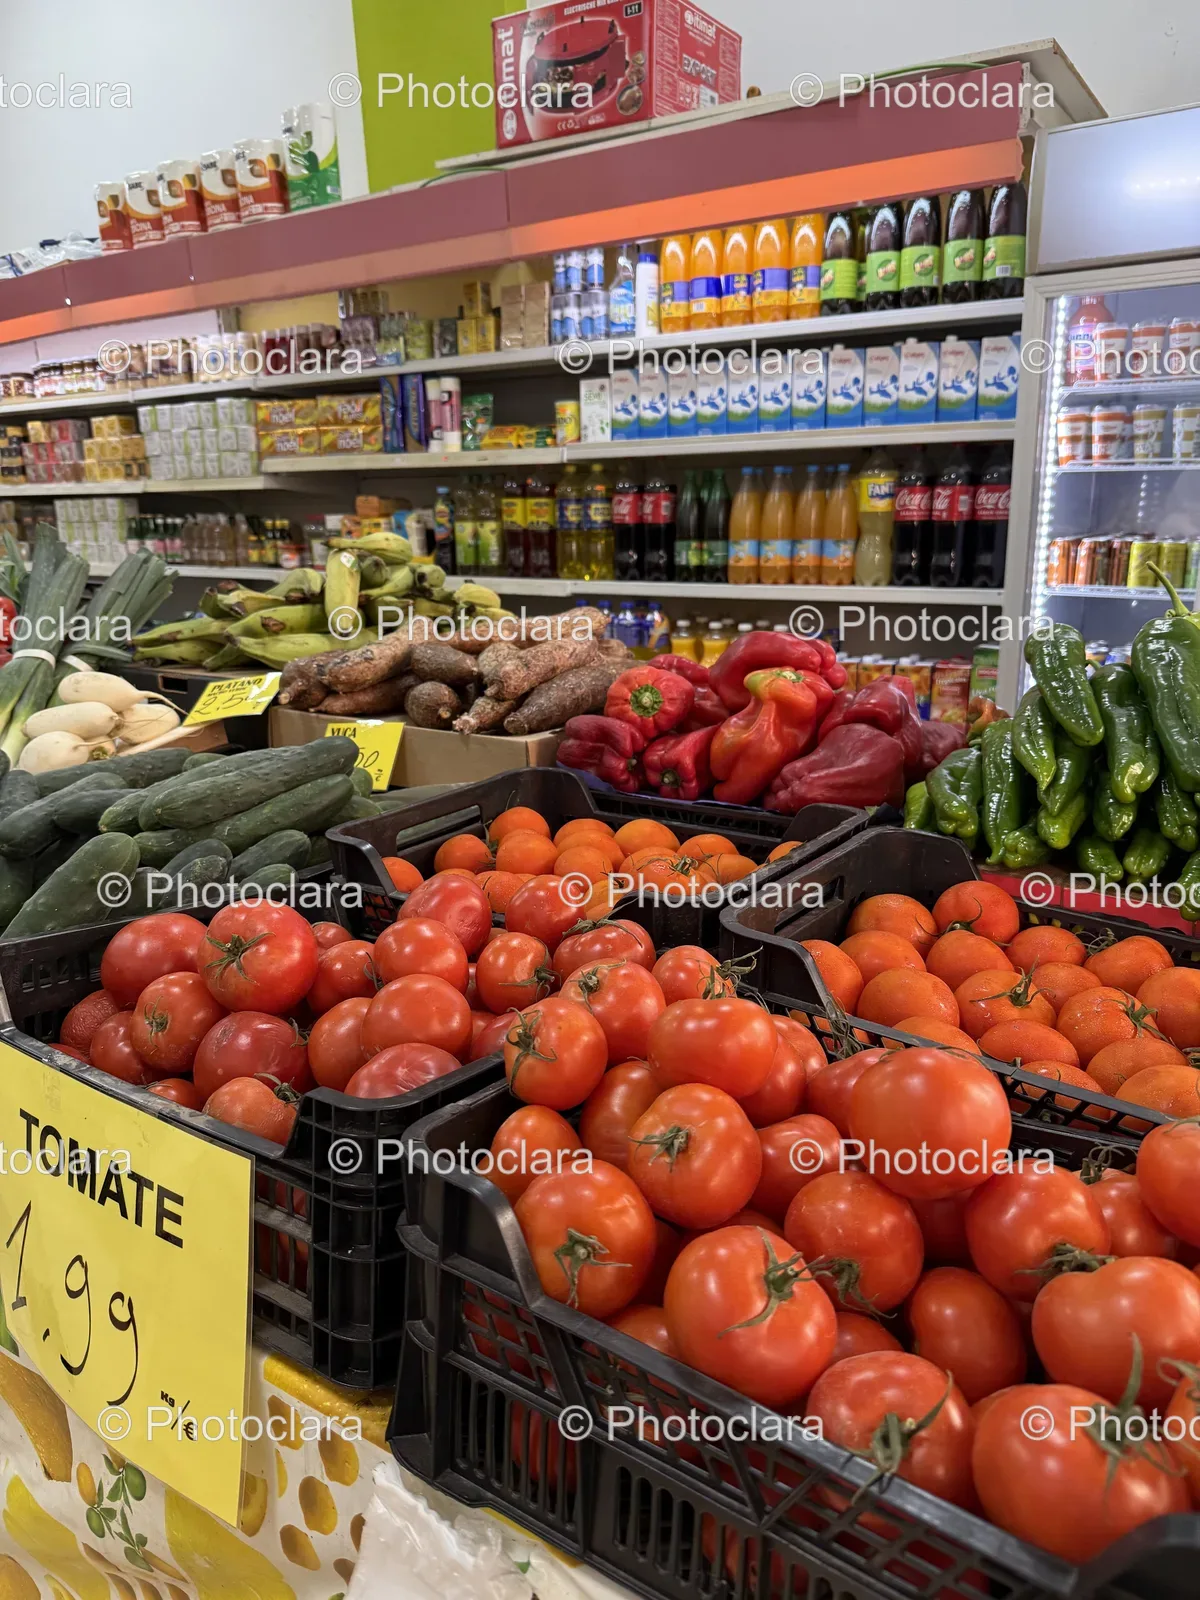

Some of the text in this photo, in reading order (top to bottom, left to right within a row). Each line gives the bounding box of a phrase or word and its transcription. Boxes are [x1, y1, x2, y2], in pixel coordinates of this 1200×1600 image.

[867, 482, 895, 498] FANT
[210, 678, 263, 693] PLATANO
[194, 691, 250, 716] 2.5
[331, 727, 357, 739] YUCA
[19, 1108, 184, 1249] TOMATE
[6, 1199, 140, 1407] 1.99
